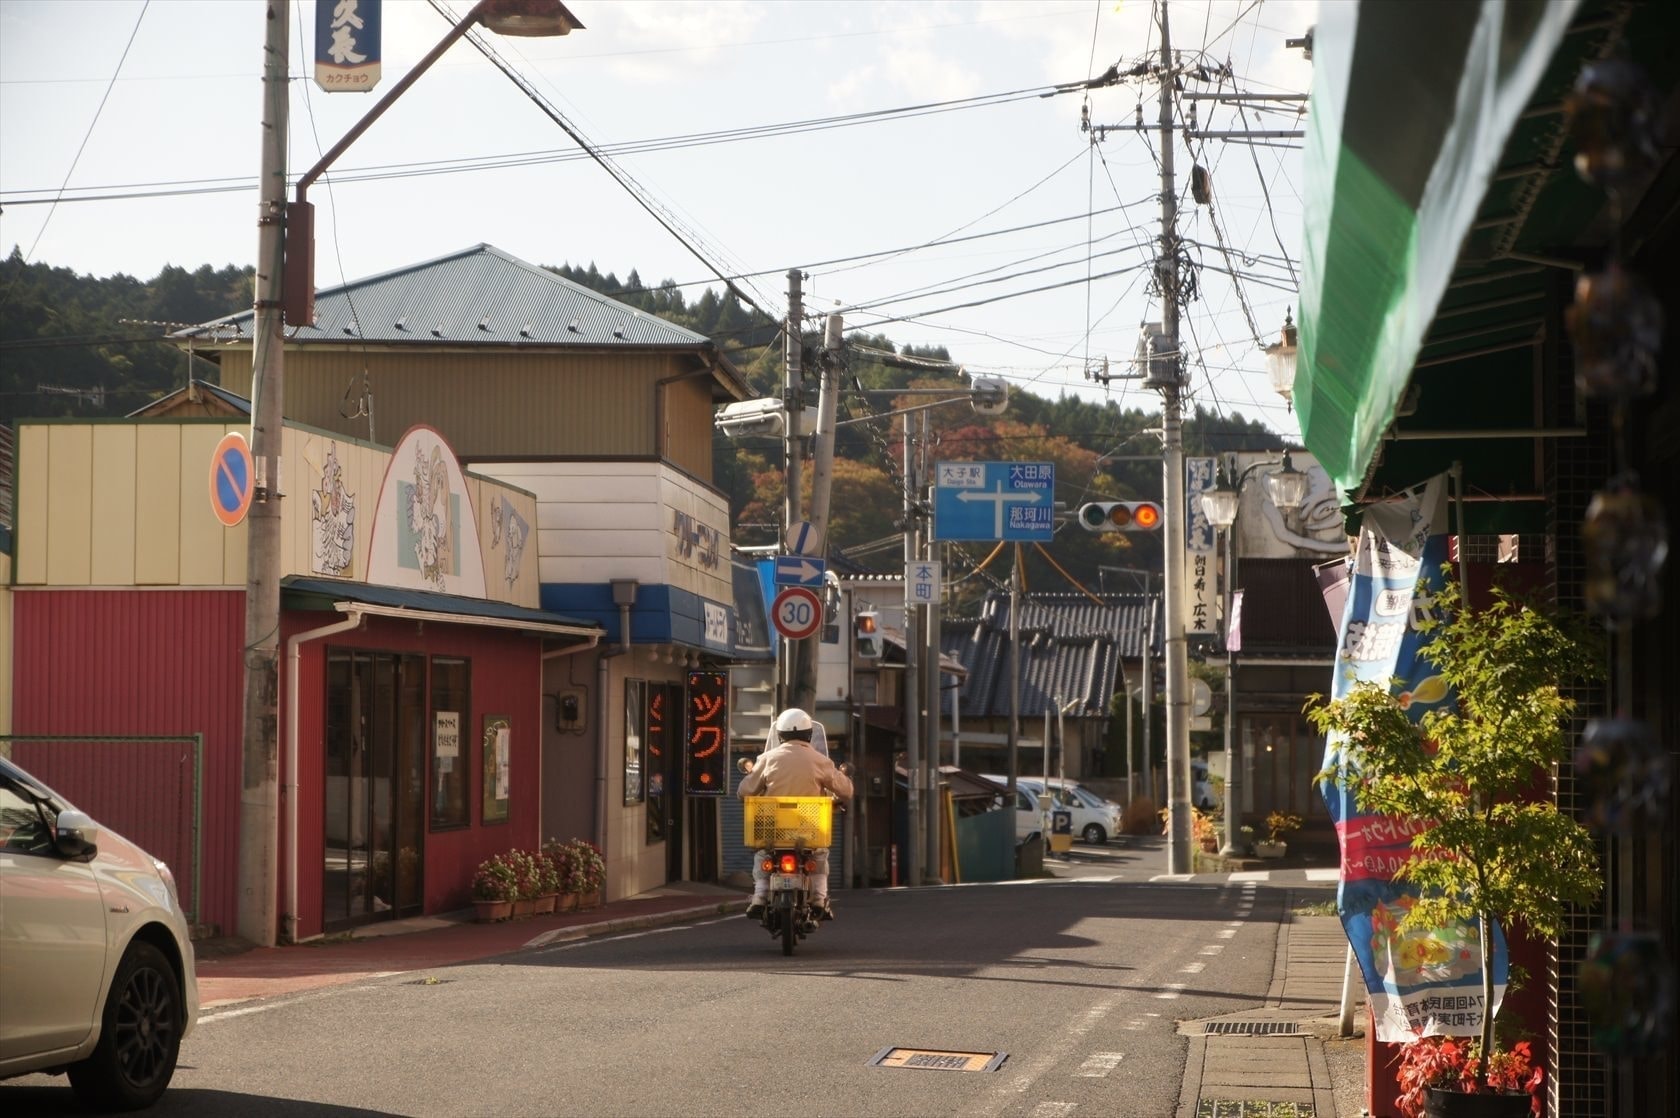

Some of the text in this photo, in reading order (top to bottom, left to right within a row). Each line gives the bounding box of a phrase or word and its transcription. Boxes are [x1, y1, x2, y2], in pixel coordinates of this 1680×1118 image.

[326, 73, 369, 83] カクチョウ
[943, 467, 981, 478] 大子駅
[1010, 465, 1051, 480] 大田原
[1014, 481, 1047, 489] Otawara
[1010, 507, 1051, 521] 那珂川
[1009, 520, 1051, 530] Nakagawa
[915, 565, 932, 599] 本町
[783, 602, 810, 625] 30
[1055, 814, 1068, 831] P
